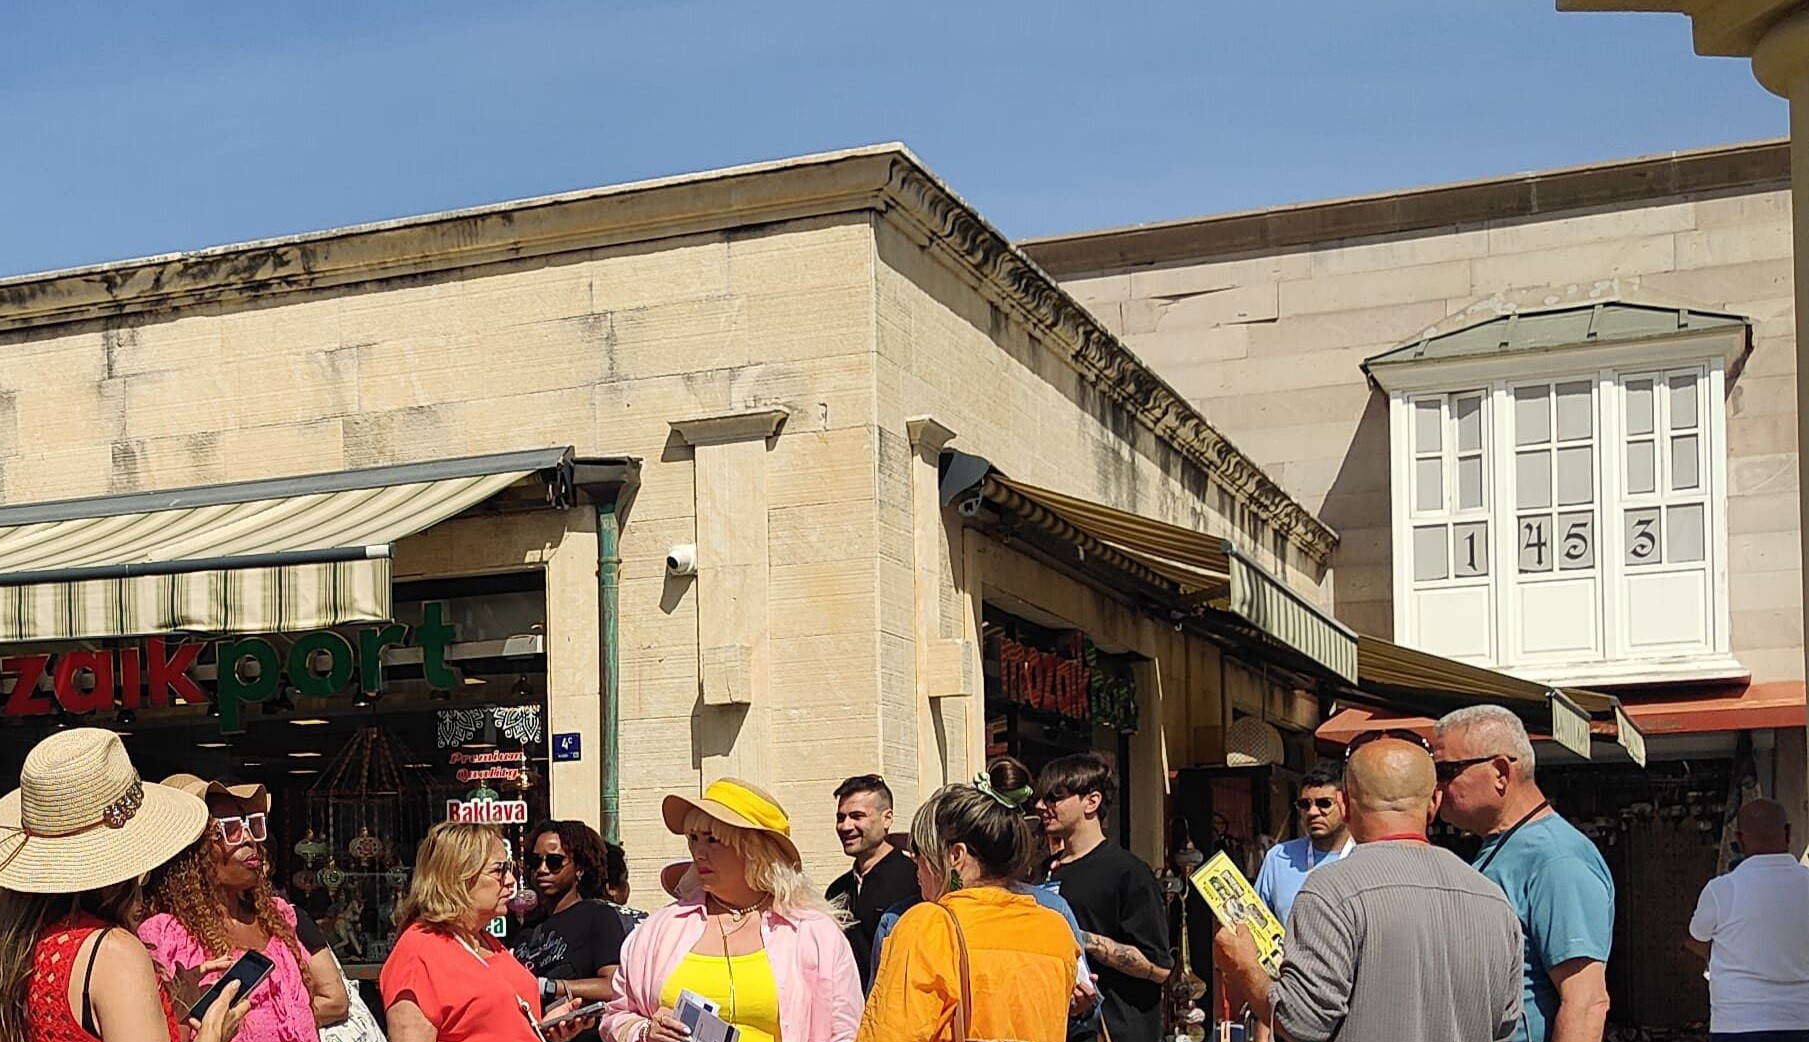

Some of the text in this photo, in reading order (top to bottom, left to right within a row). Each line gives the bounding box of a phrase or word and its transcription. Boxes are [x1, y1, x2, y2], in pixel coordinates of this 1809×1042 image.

[449, 750, 523, 764] Premium
[456, 766, 520, 782] Quality
[448, 799, 527, 823] Baklava
